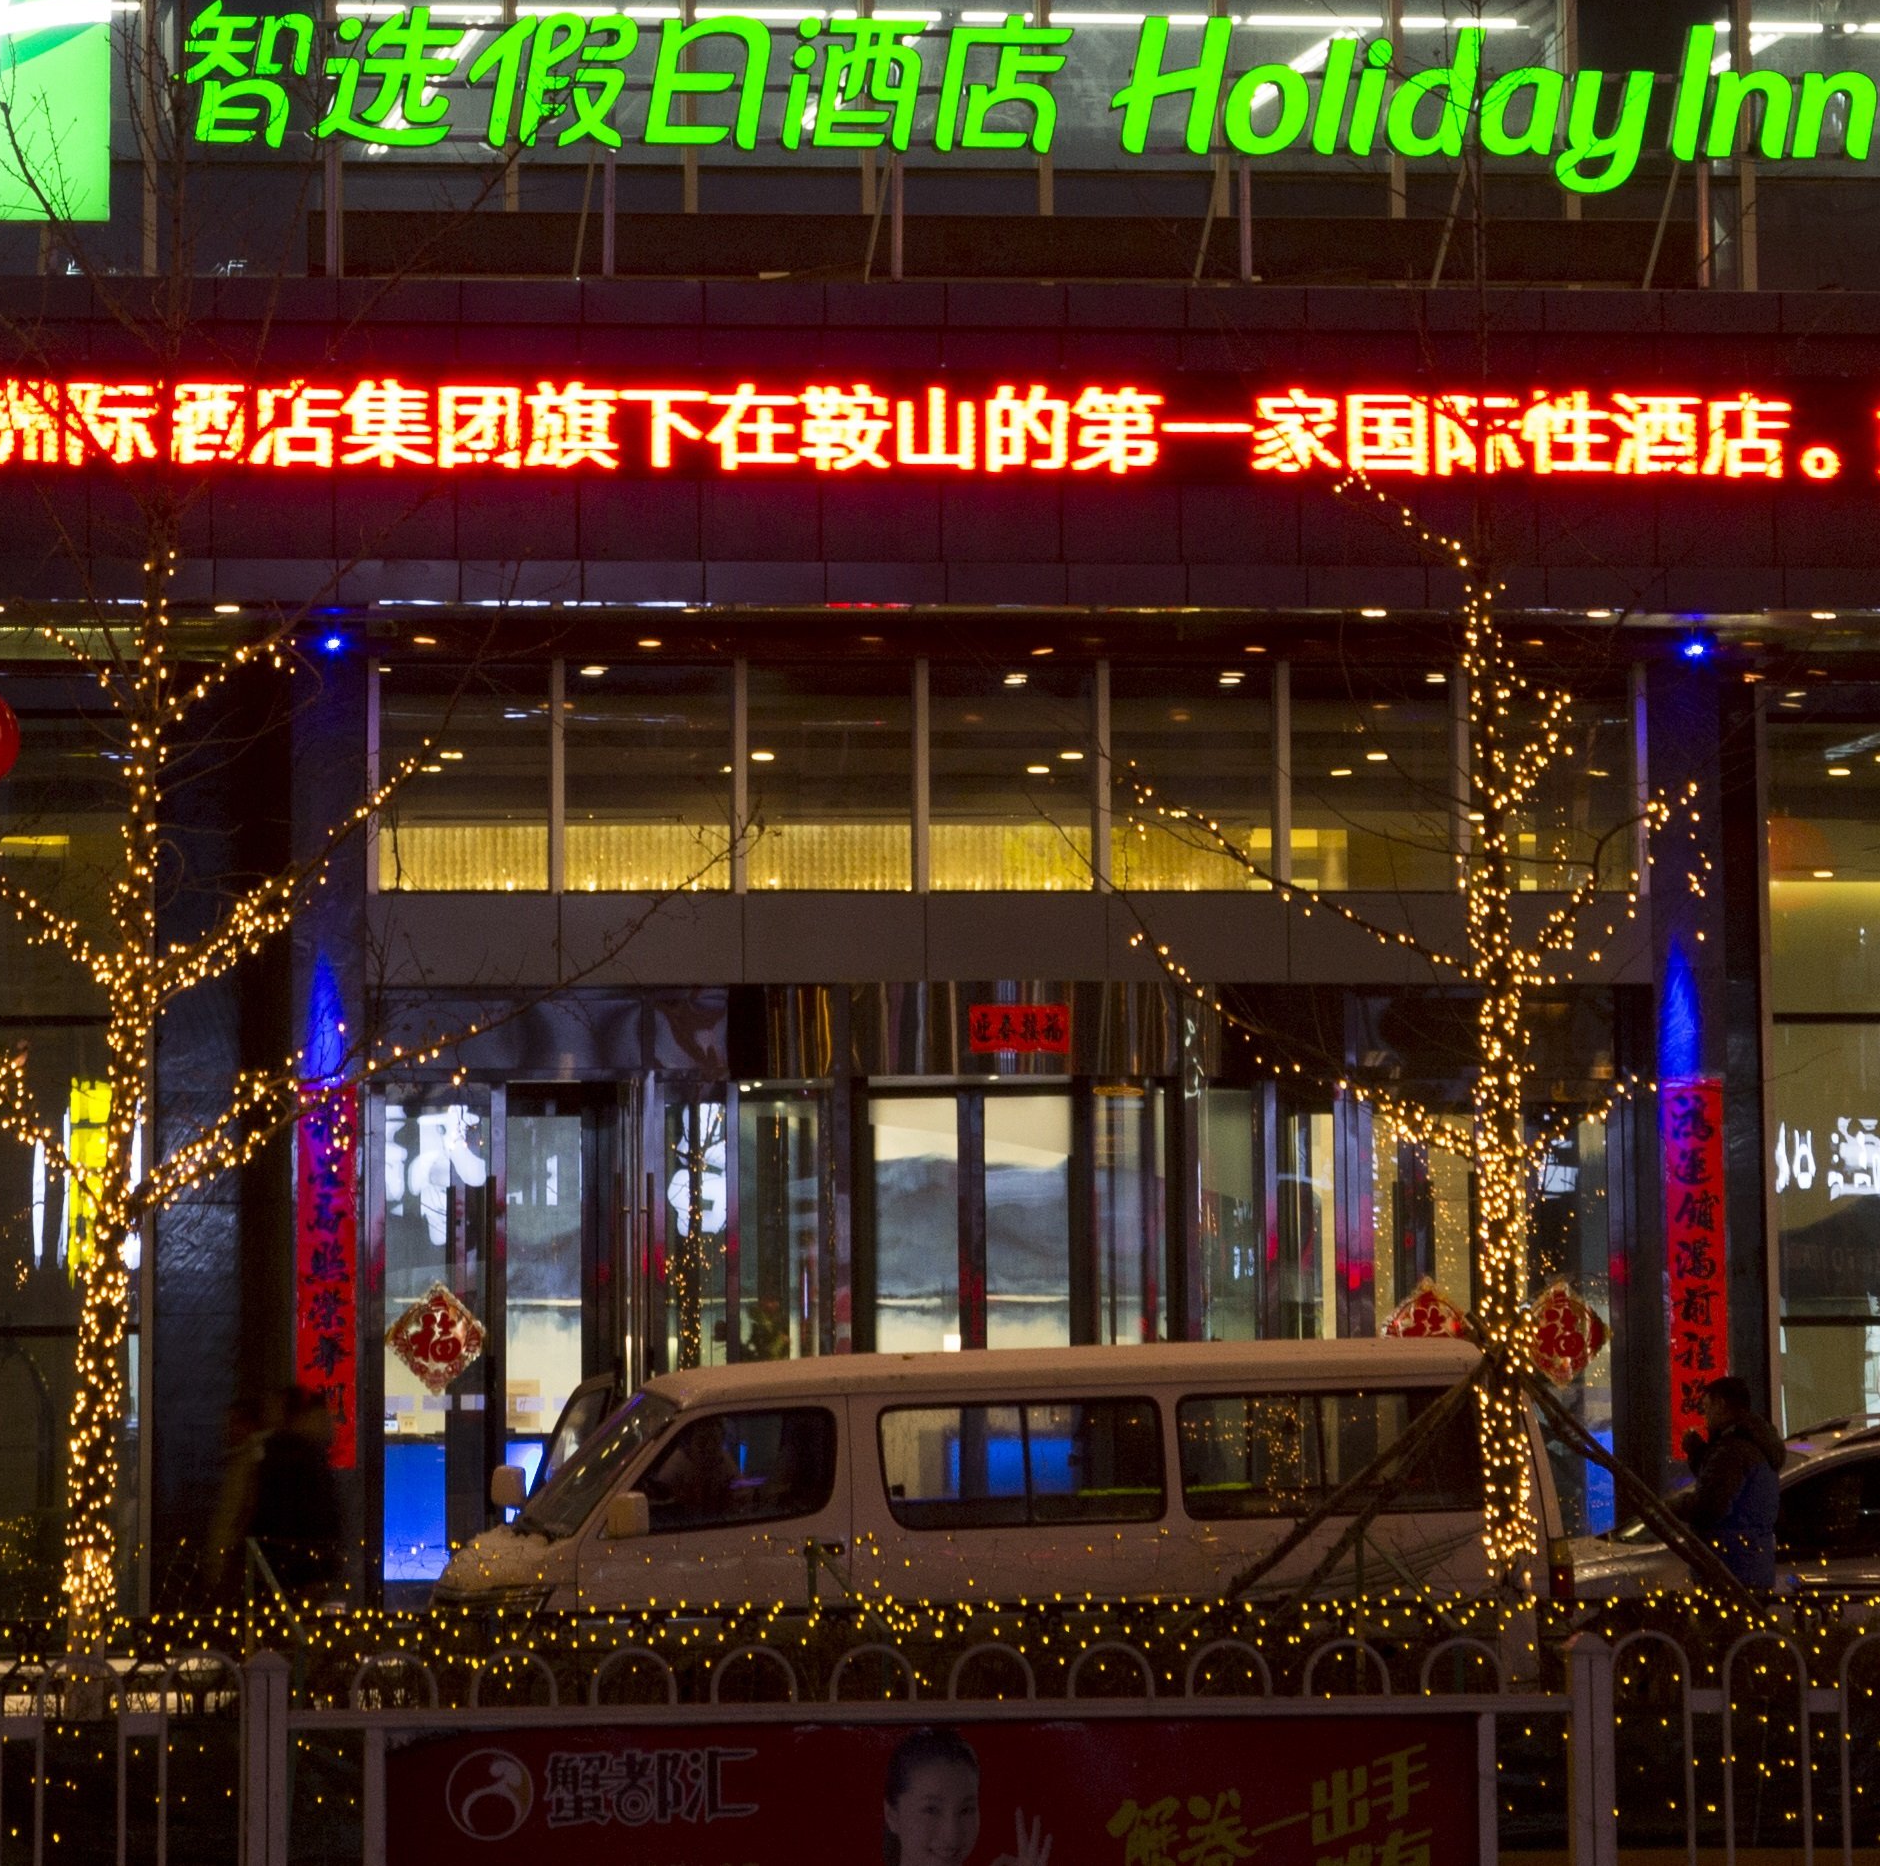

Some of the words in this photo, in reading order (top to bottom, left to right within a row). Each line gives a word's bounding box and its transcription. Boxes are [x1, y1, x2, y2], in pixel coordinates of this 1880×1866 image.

[1110, 14, 1656, 194] Holiday
[1671, 23, 1878, 162] Inn
[409, 1311, 462, 1362] 福
[1535, 1307, 1586, 1358] 福
